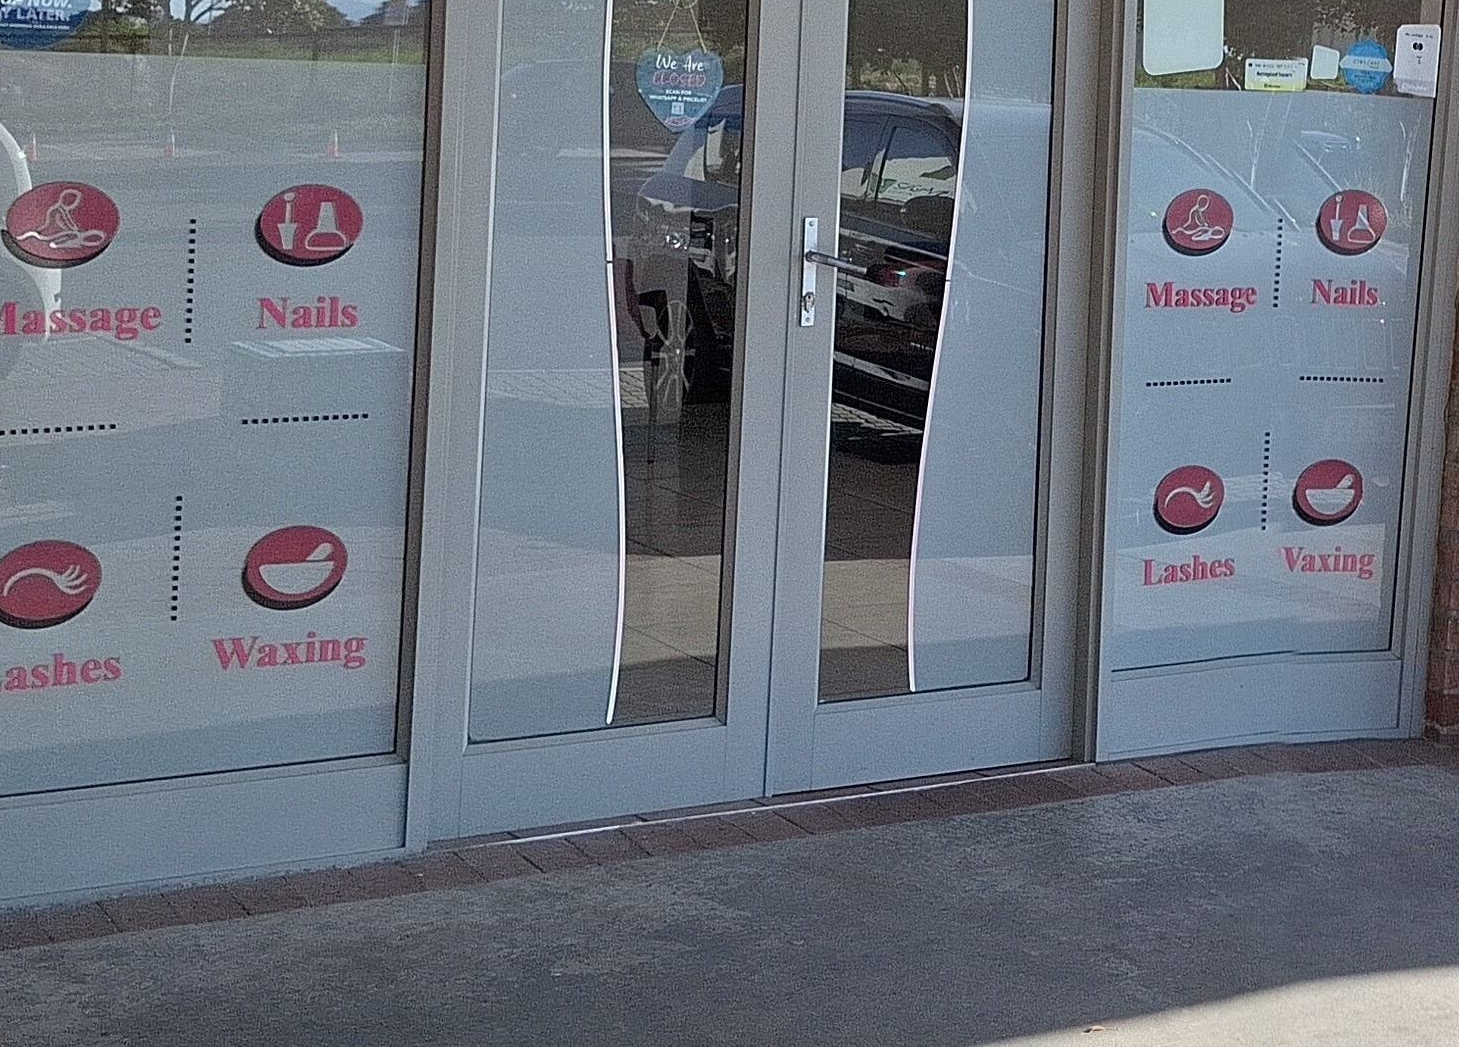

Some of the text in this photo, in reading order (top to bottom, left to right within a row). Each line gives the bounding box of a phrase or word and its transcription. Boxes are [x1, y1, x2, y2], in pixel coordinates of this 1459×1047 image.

[655, 53, 705, 73] We Are
[1143, 281, 1258, 313] Massage
[1311, 279, 1379, 306] Nails
[255, 296, 359, 330] Nails
[1142, 555, 1236, 587] Lashes
[211, 631, 369, 671] Waxing
[0, 652, 121, 691] ashes
